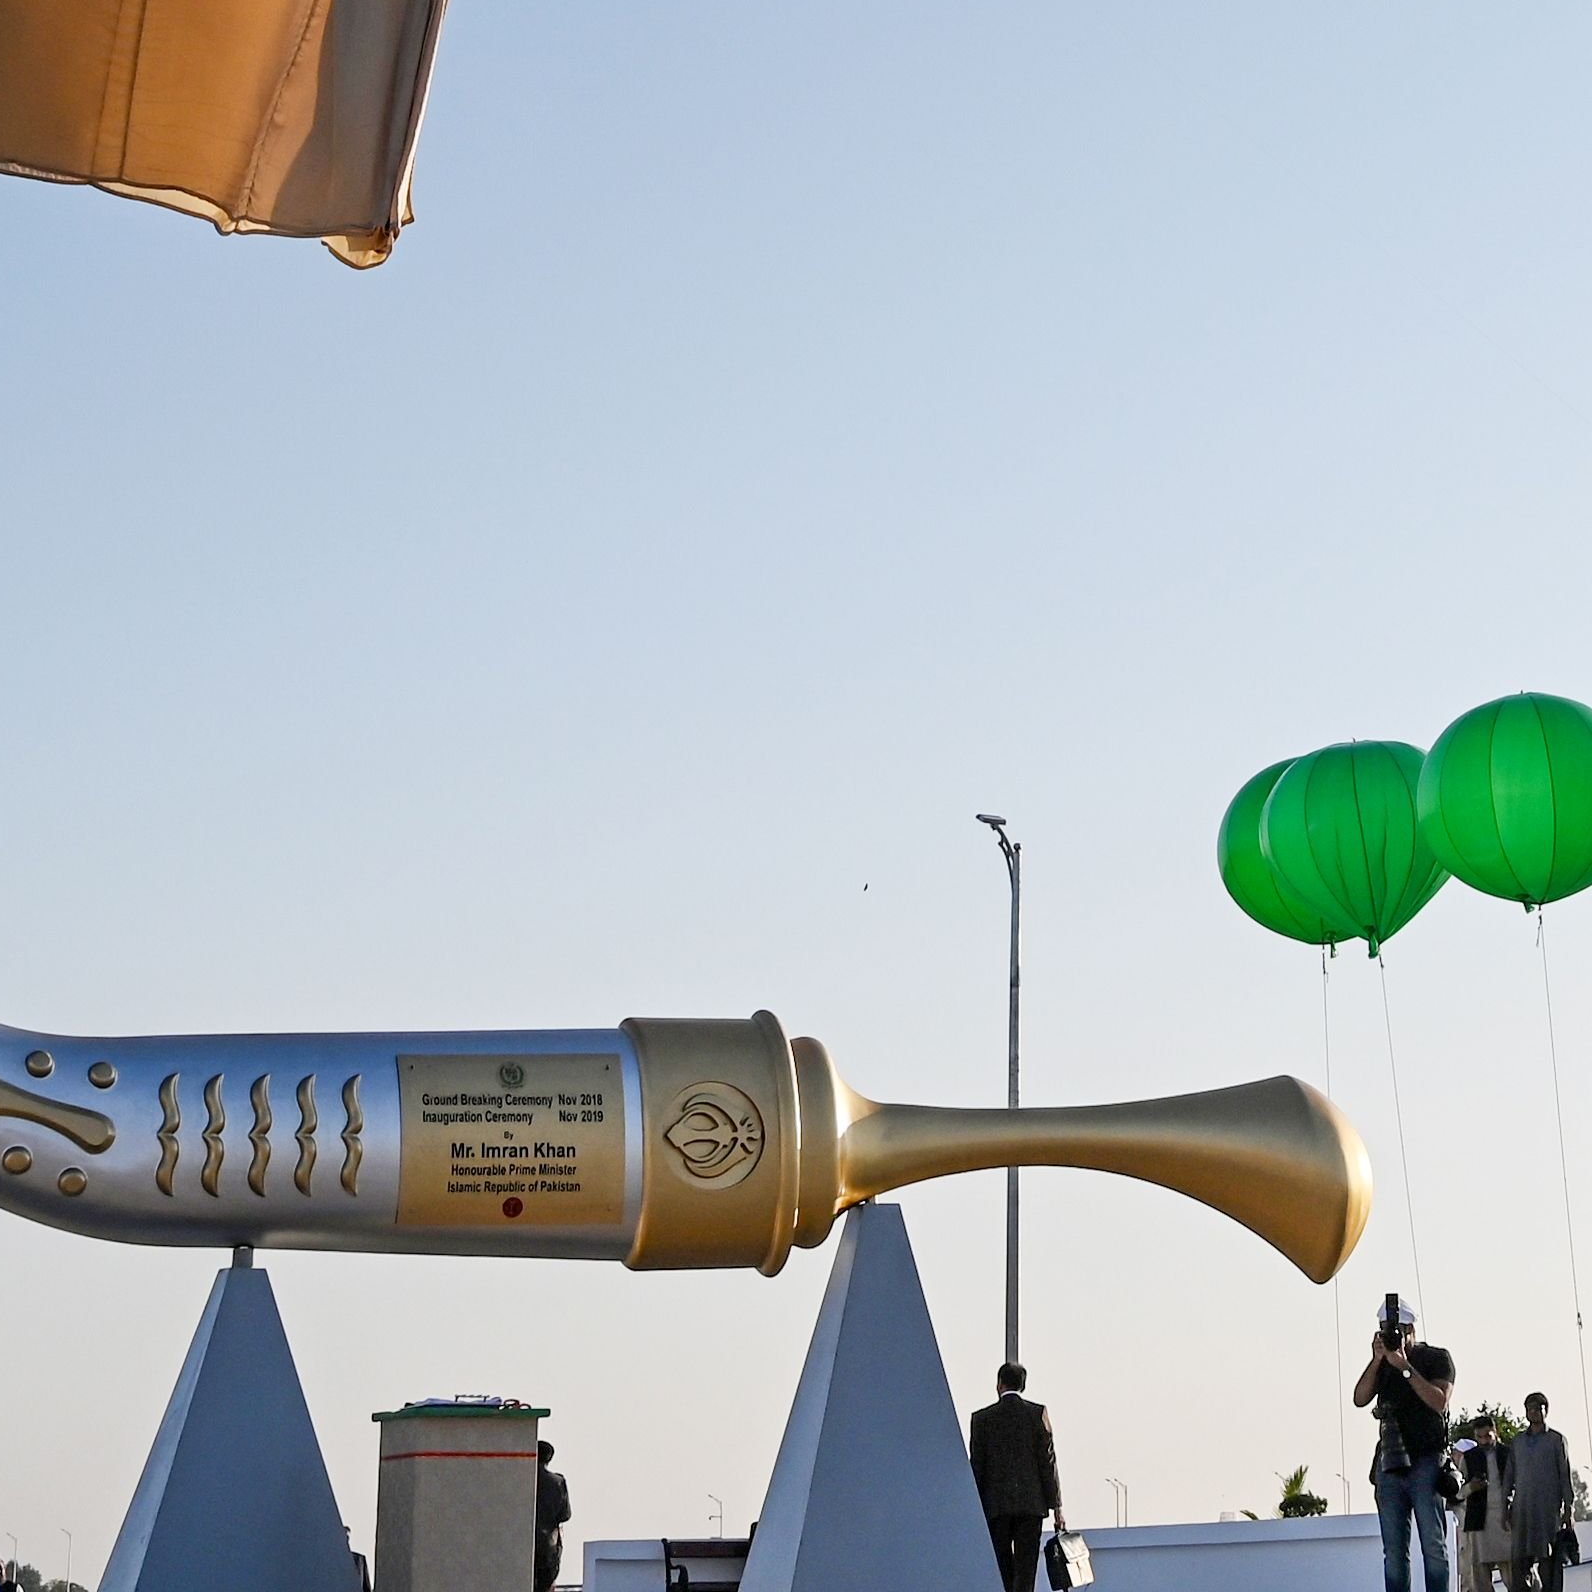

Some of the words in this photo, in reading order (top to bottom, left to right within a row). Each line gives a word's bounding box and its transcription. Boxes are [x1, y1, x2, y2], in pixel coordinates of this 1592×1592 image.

[422, 1094, 458, 1106] Ground
[460, 1094, 503, 1108] Breaking
[505, 1094, 553, 1108] Ceremony
[558, 1094, 577, 1106] Nov
[580, 1094, 603, 1106] 2018
[422, 1110, 483, 1125] Inauguration
[485, 1110, 533, 1125] Ceremony
[559, 1110, 578, 1122] Nov
[581, 1110, 604, 1122] 2019
[503, 1131, 514, 1140] By
[451, 1143, 475, 1158] Mr.
[481, 1143, 529, 1158] Imran
[534, 1143, 576, 1158] Khan
[451, 1164, 506, 1176] Honourable
[509, 1164, 536, 1176] Prime
[539, 1163, 576, 1176] Minister
[447, 1181, 481, 1193] Islamic
[484, 1181, 525, 1195] Republic
[528, 1181, 538, 1192] of
[540, 1181, 581, 1192] Pakistan
